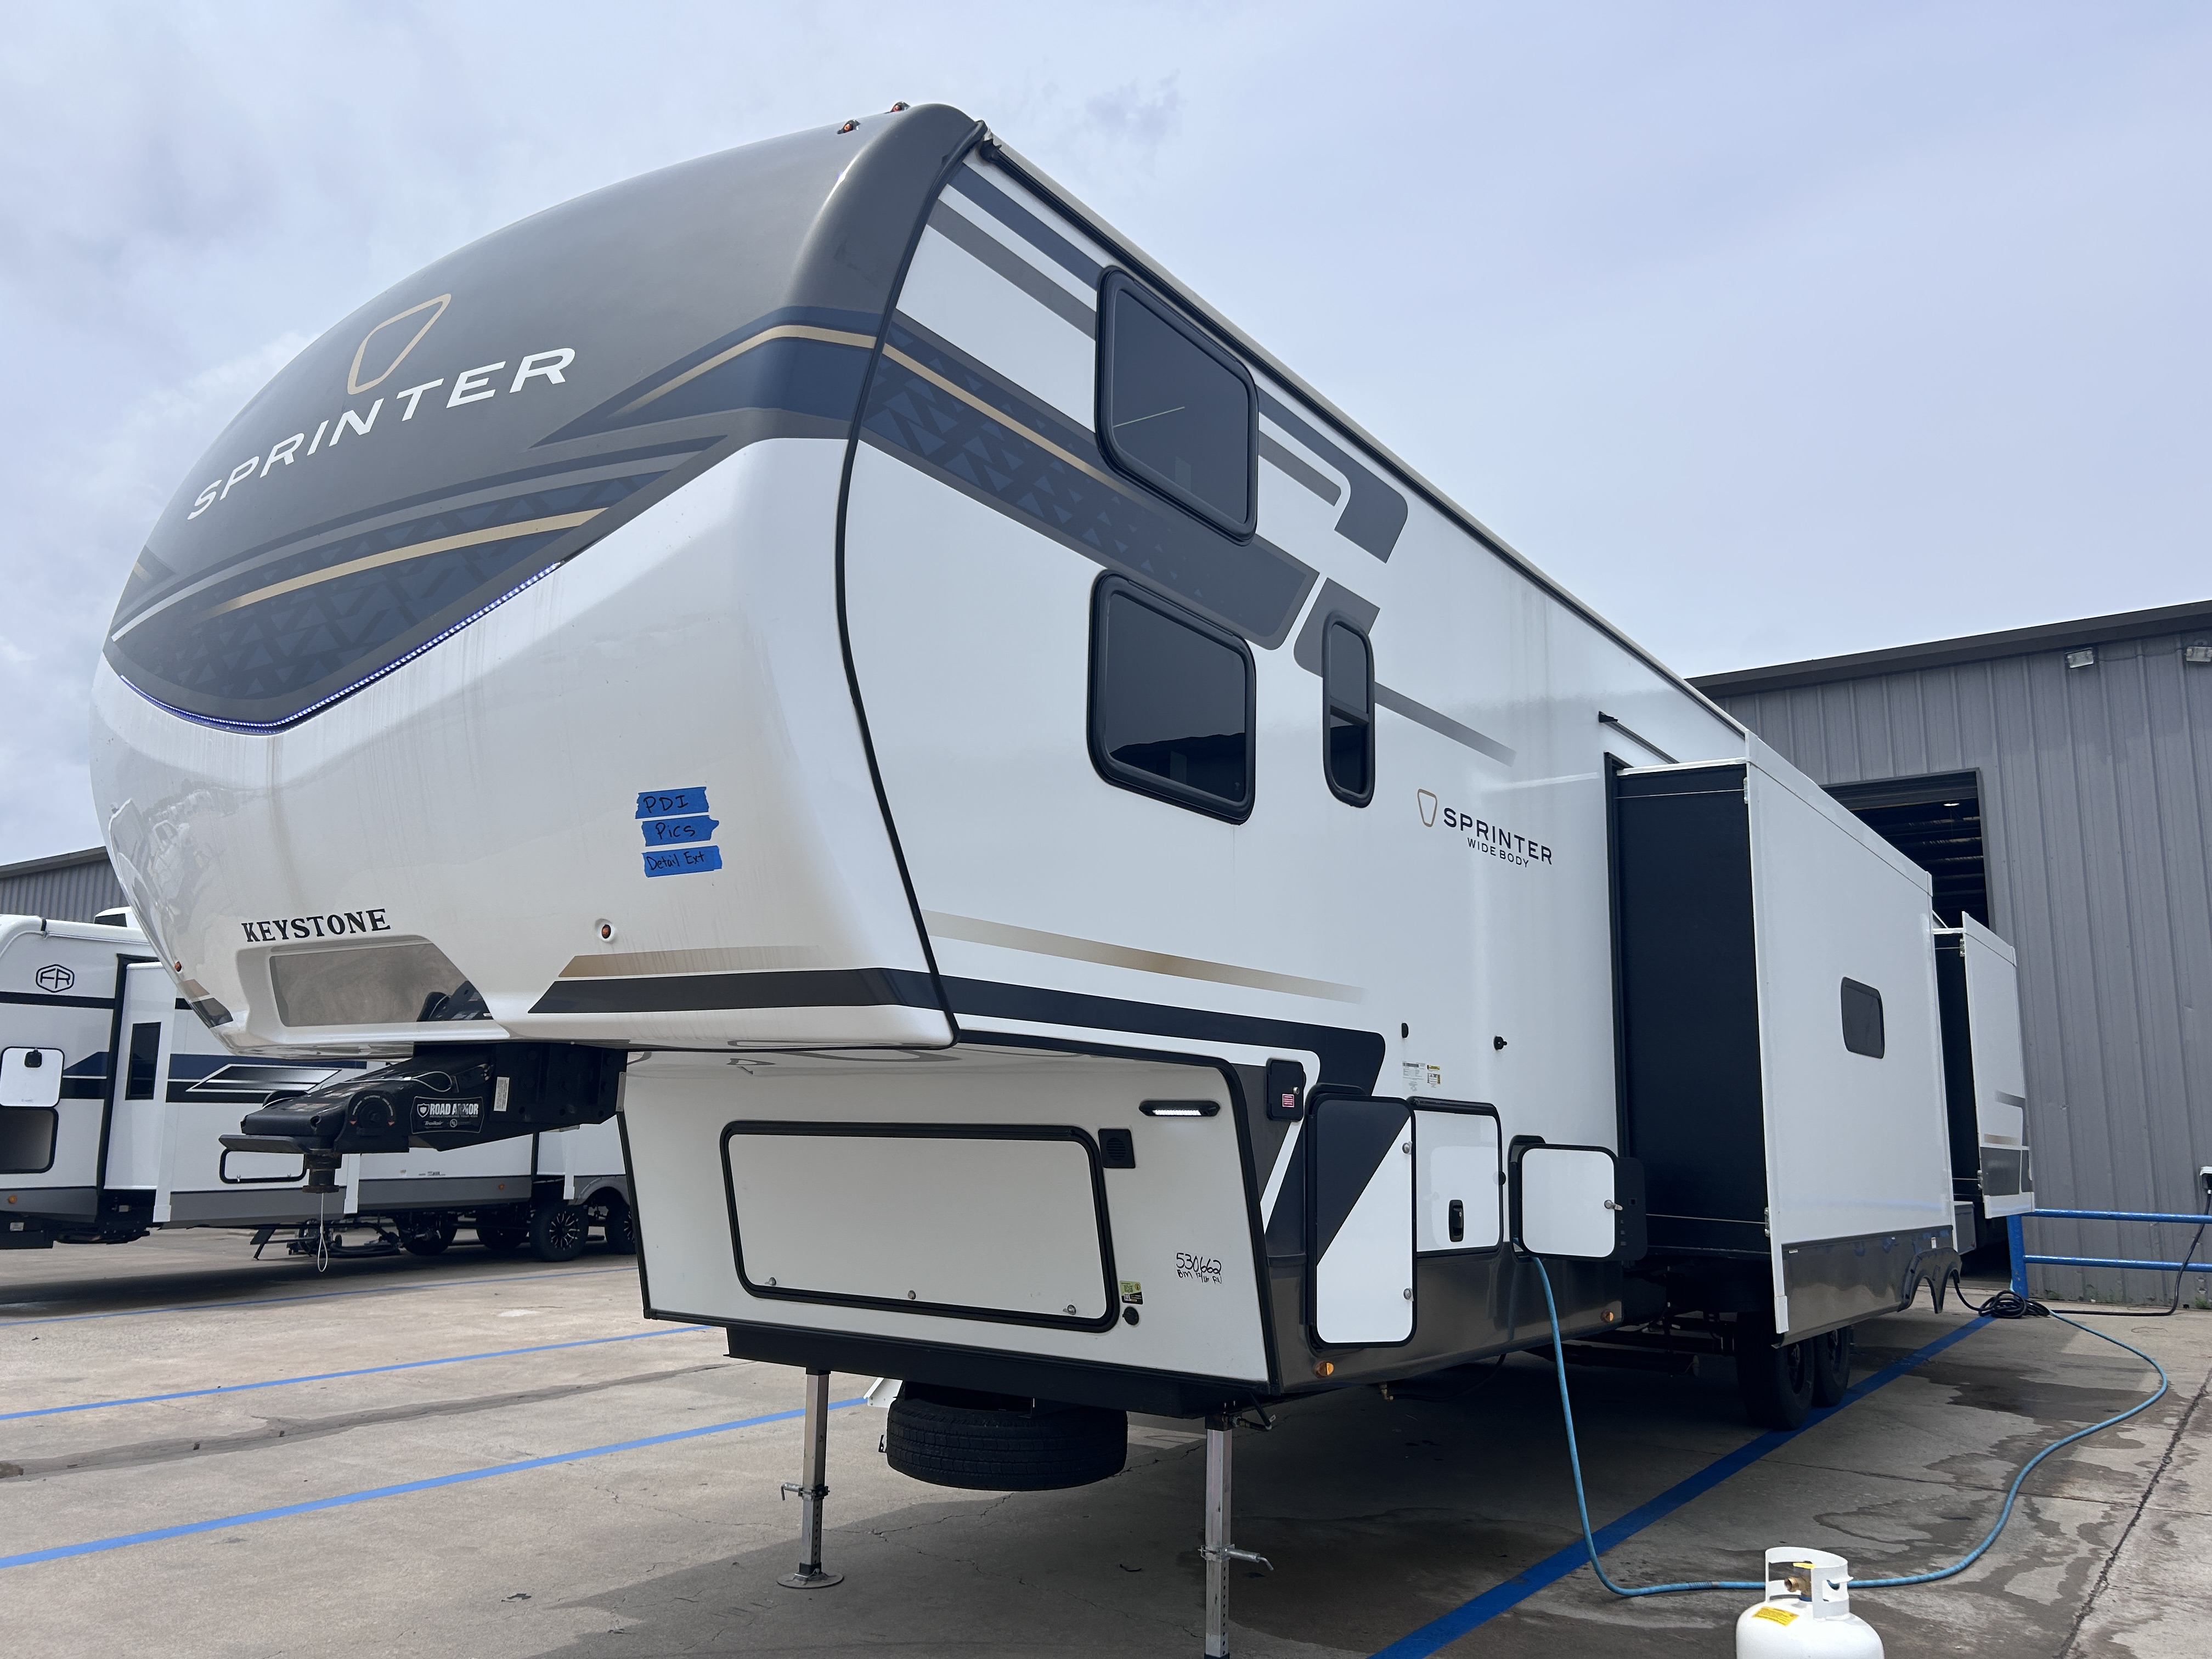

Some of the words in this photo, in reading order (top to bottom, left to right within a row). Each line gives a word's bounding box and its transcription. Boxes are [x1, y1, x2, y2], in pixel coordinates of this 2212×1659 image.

[187, 347, 575, 520] SPRINTER
[643, 795, 689, 813] PDI
[655, 822, 696, 839] Pics
[1443, 808, 1552, 865] SPRINTER
[646, 854, 680, 870] Detail
[684, 851, 704, 864] Ext
[1467, 837, 1497, 856] WIDE
[1499, 850, 1529, 867] BODY
[241, 909, 391, 942] KEYSTONE
[40, 968, 71, 989] FR
[429, 1103, 451, 1115] ROAD
[452, 1103, 479, 1115] ARMOR
[1176, 1252, 1222, 1276] 530662
